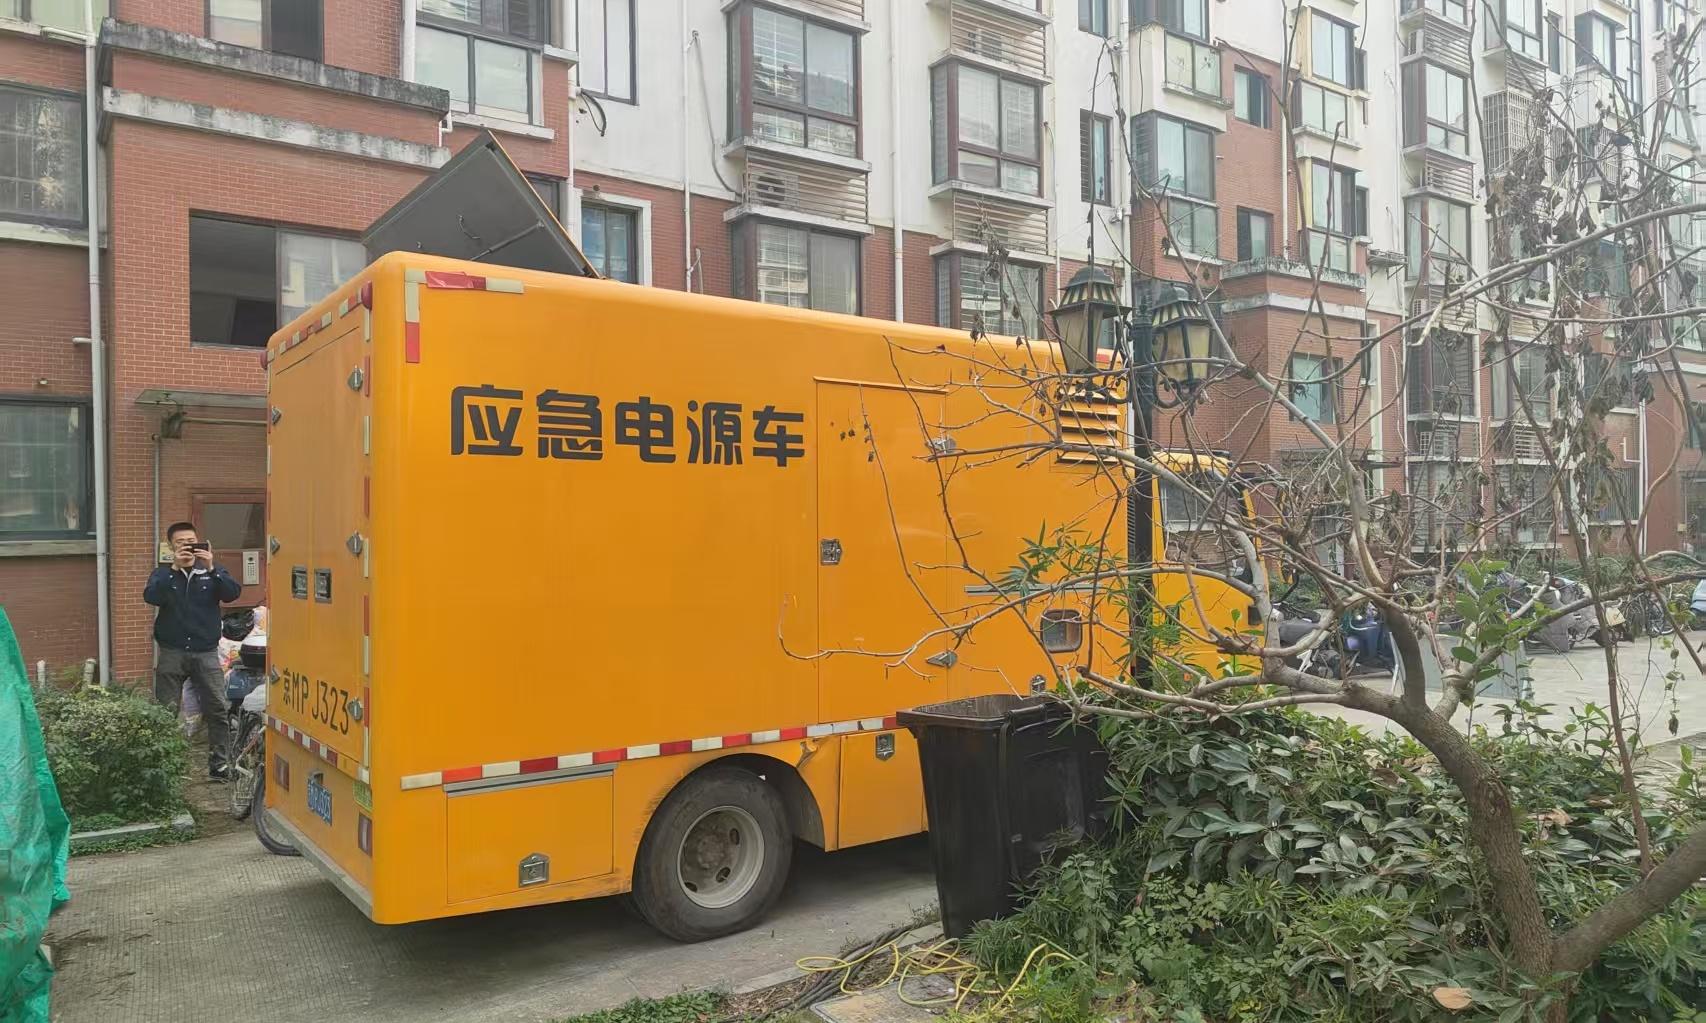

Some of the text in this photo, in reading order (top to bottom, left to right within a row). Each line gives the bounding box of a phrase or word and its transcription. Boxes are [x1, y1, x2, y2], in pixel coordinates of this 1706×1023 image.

[450, 384, 806, 467] 应急电源车
